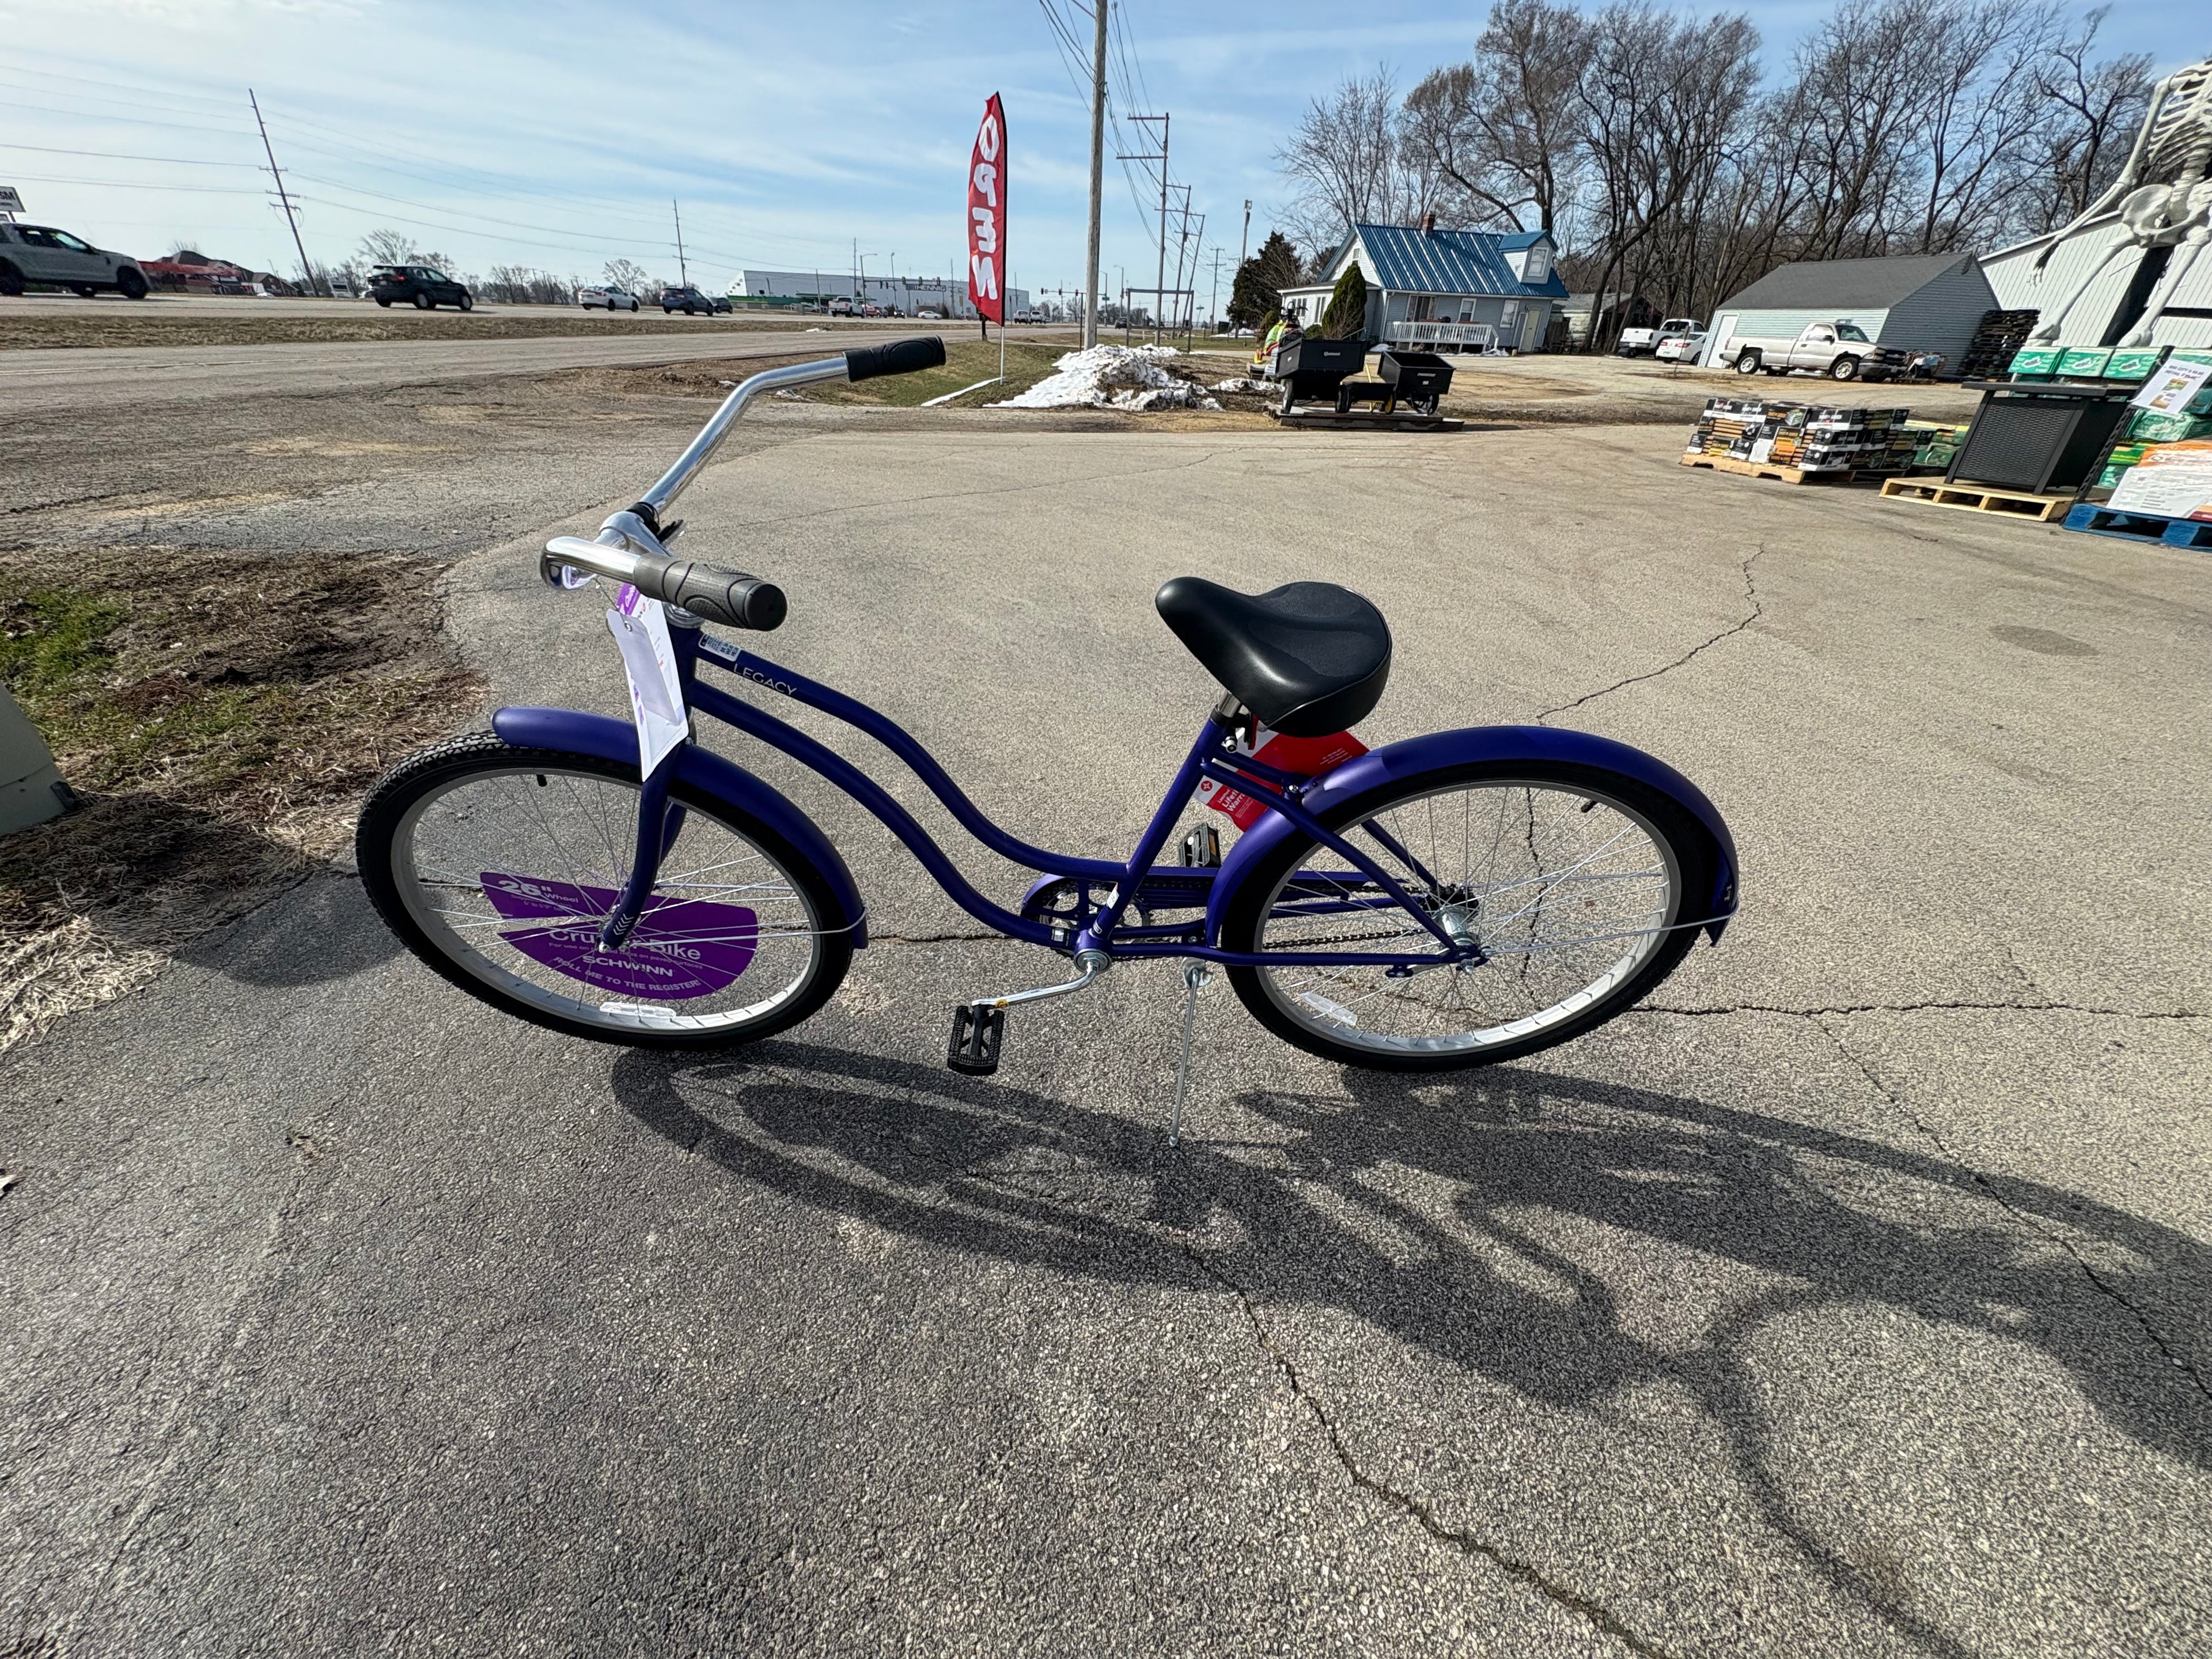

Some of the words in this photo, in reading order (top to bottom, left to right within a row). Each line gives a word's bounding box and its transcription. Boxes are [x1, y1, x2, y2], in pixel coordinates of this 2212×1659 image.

[733, 663, 797, 695] LEGACY
[498, 880, 552, 896] 26"
[544, 892, 579, 903] Wheel
[650, 938, 701, 960] Bike
[553, 956, 582, 973] ROLL
[585, 968, 604, 980] ME
[605, 976, 621, 985] TO
[624, 980, 646, 990] THE
[649, 979, 702, 991] REGISTER!
[582, 956, 673, 977] SCHWINN
